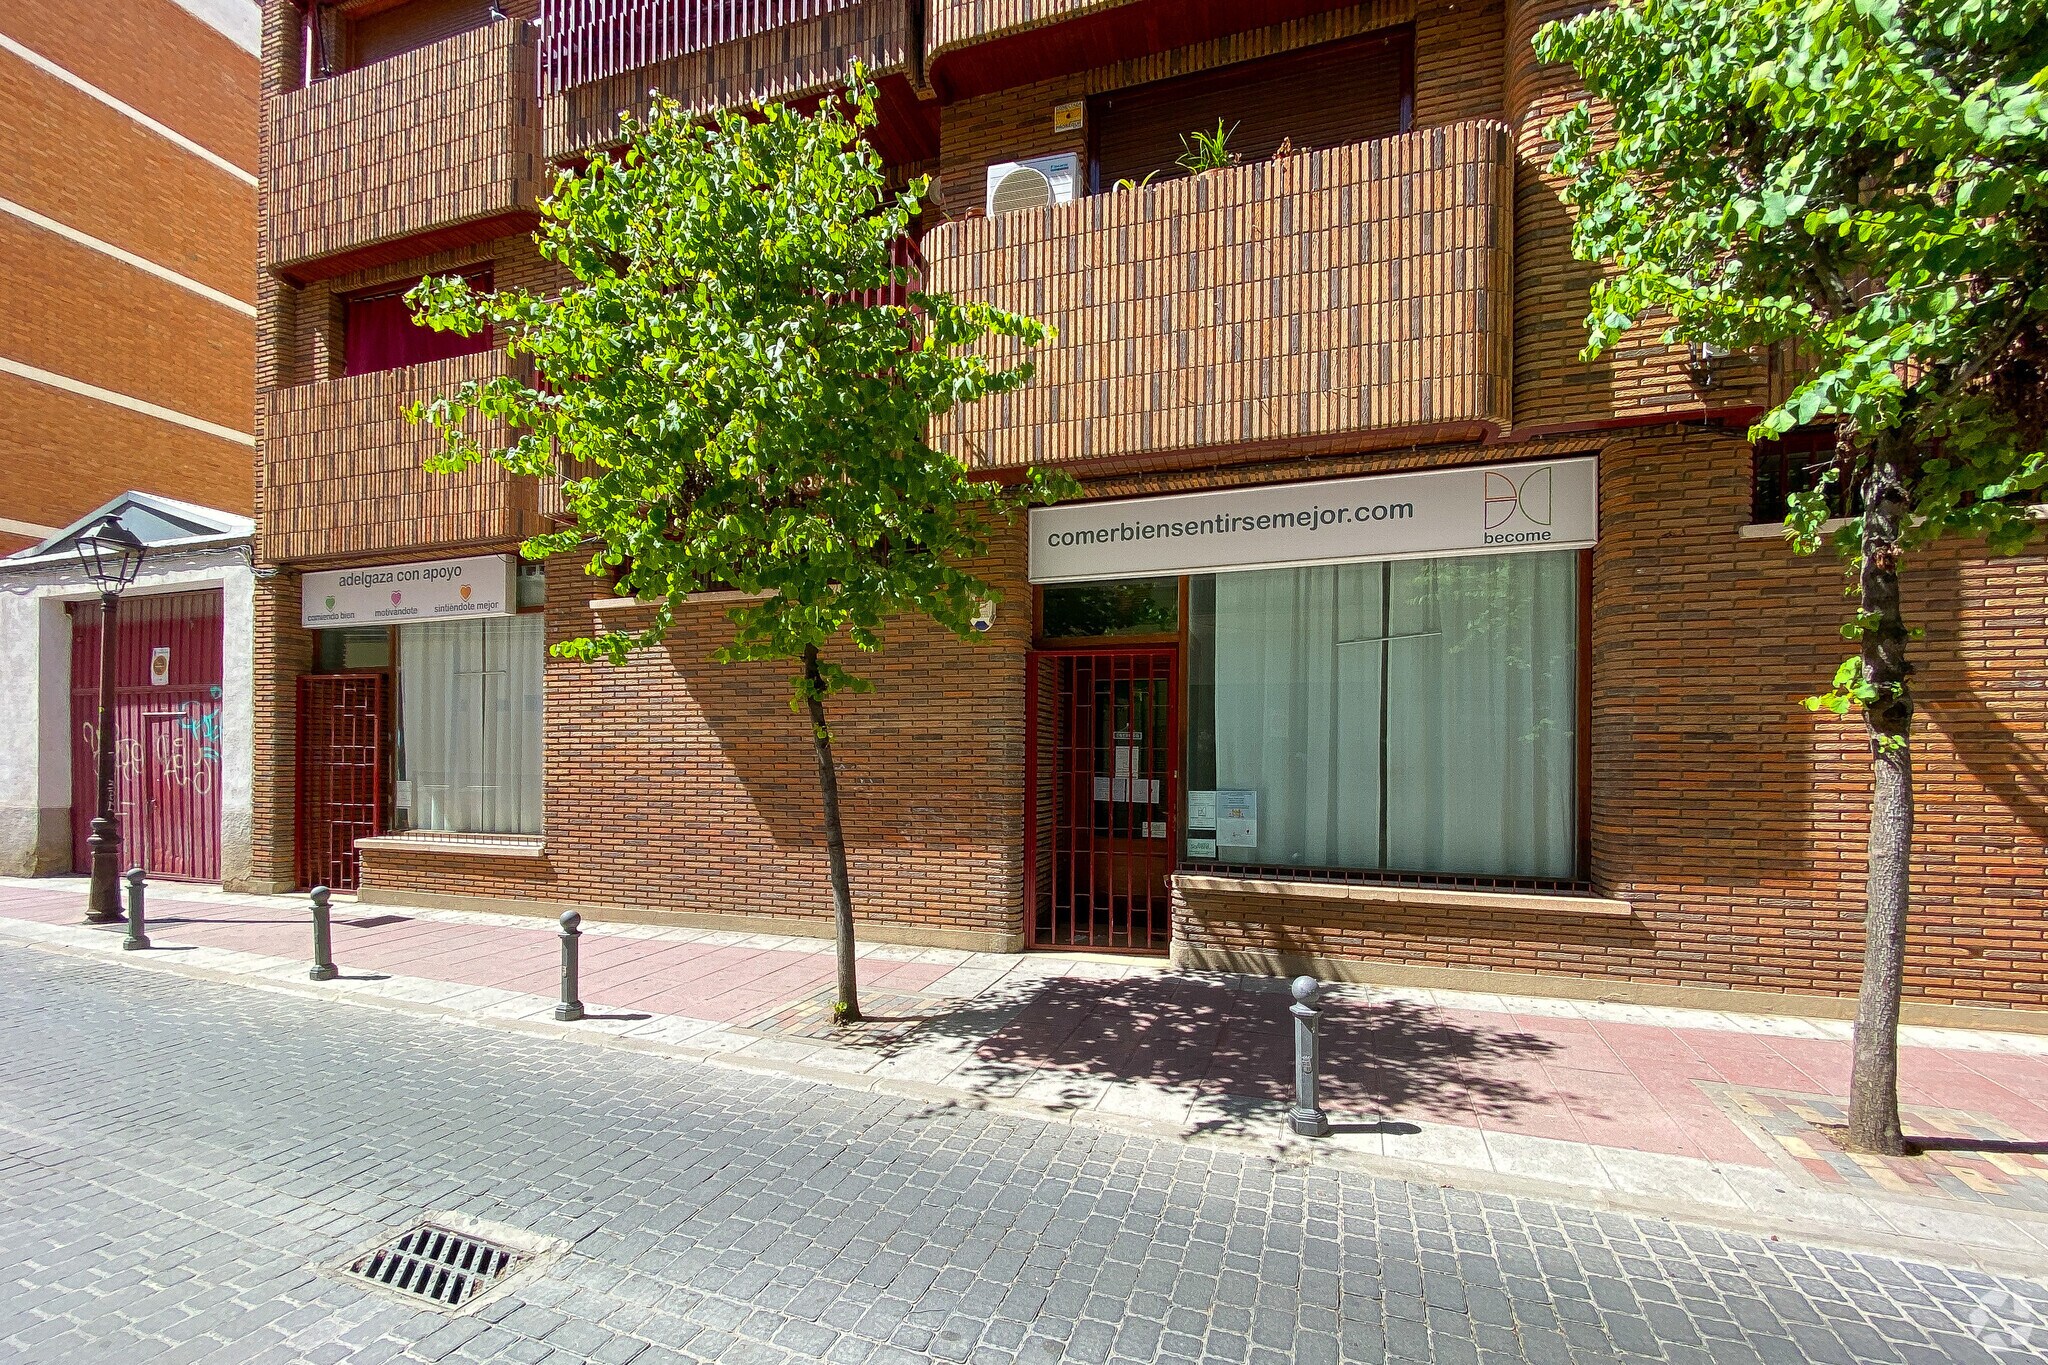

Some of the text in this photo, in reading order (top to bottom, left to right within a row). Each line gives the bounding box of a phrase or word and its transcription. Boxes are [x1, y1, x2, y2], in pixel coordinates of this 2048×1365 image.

[1048, 500, 1414, 547] comerbiensentirsemejor.com
[1484, 531, 1552, 544] become
[339, 565, 462, 588] adelgaza con apoyo
[476, 599, 499, 611] mejor
[307, 611, 355, 622] comiendo bien
